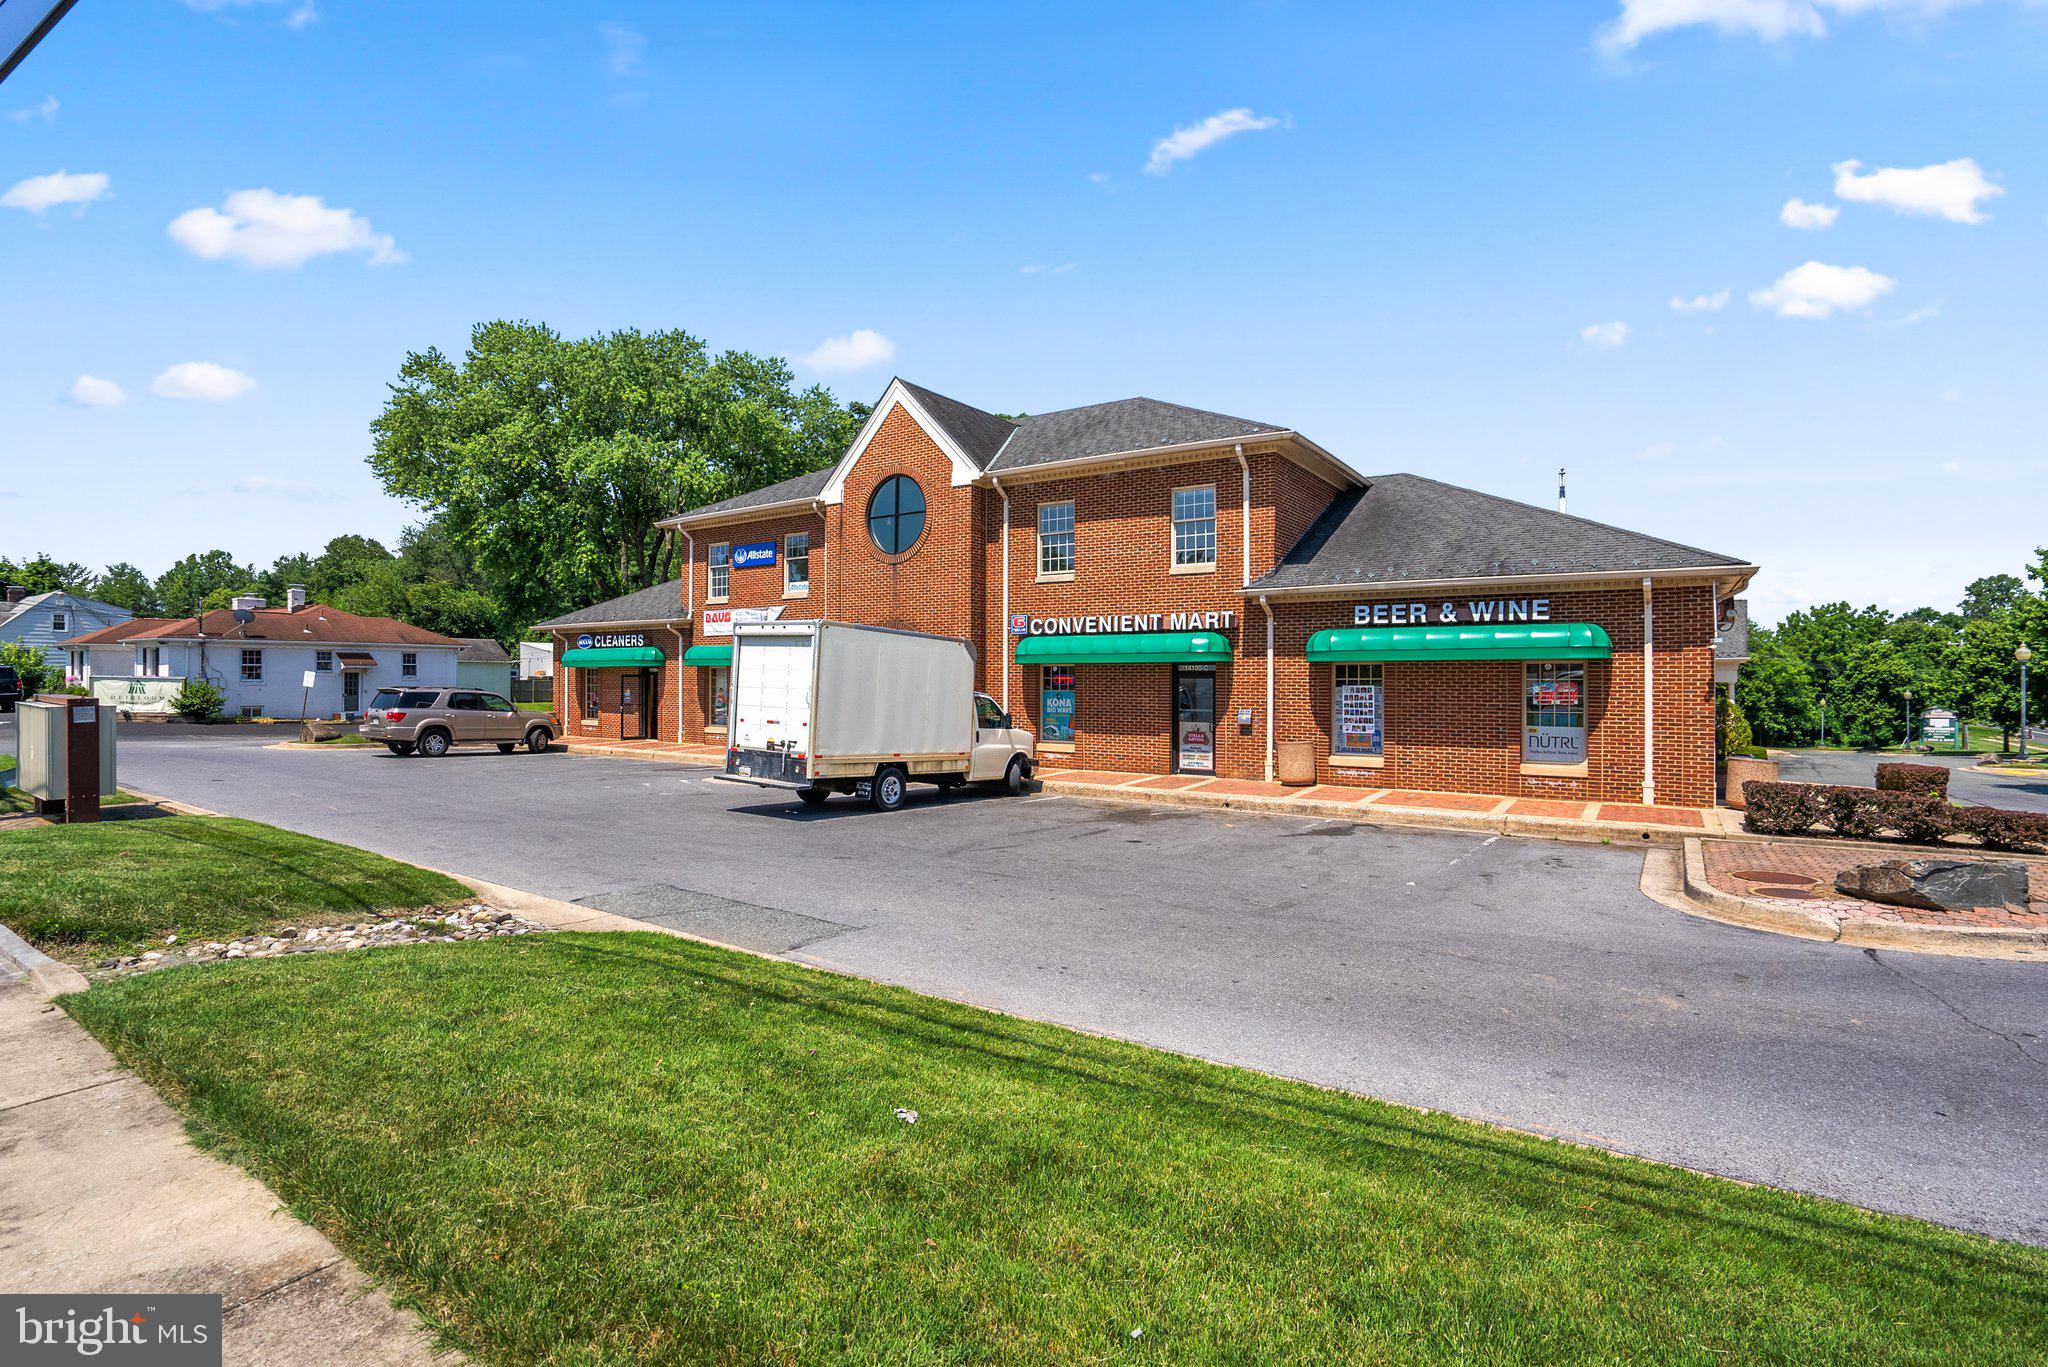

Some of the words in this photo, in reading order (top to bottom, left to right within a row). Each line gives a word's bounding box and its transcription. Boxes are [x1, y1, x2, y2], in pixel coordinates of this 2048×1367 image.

[747, 549, 773, 560] Allstate
[1354, 603, 1428, 625] BEER
[1439, 602, 1458, 623] &
[1469, 599, 1550, 622] WINE
[1030, 613, 1162, 635] CONVENIENT
[1170, 611, 1234, 631] MART
[594, 634, 644, 647] CLEANERS
[1046, 698, 1072, 707] KONA
